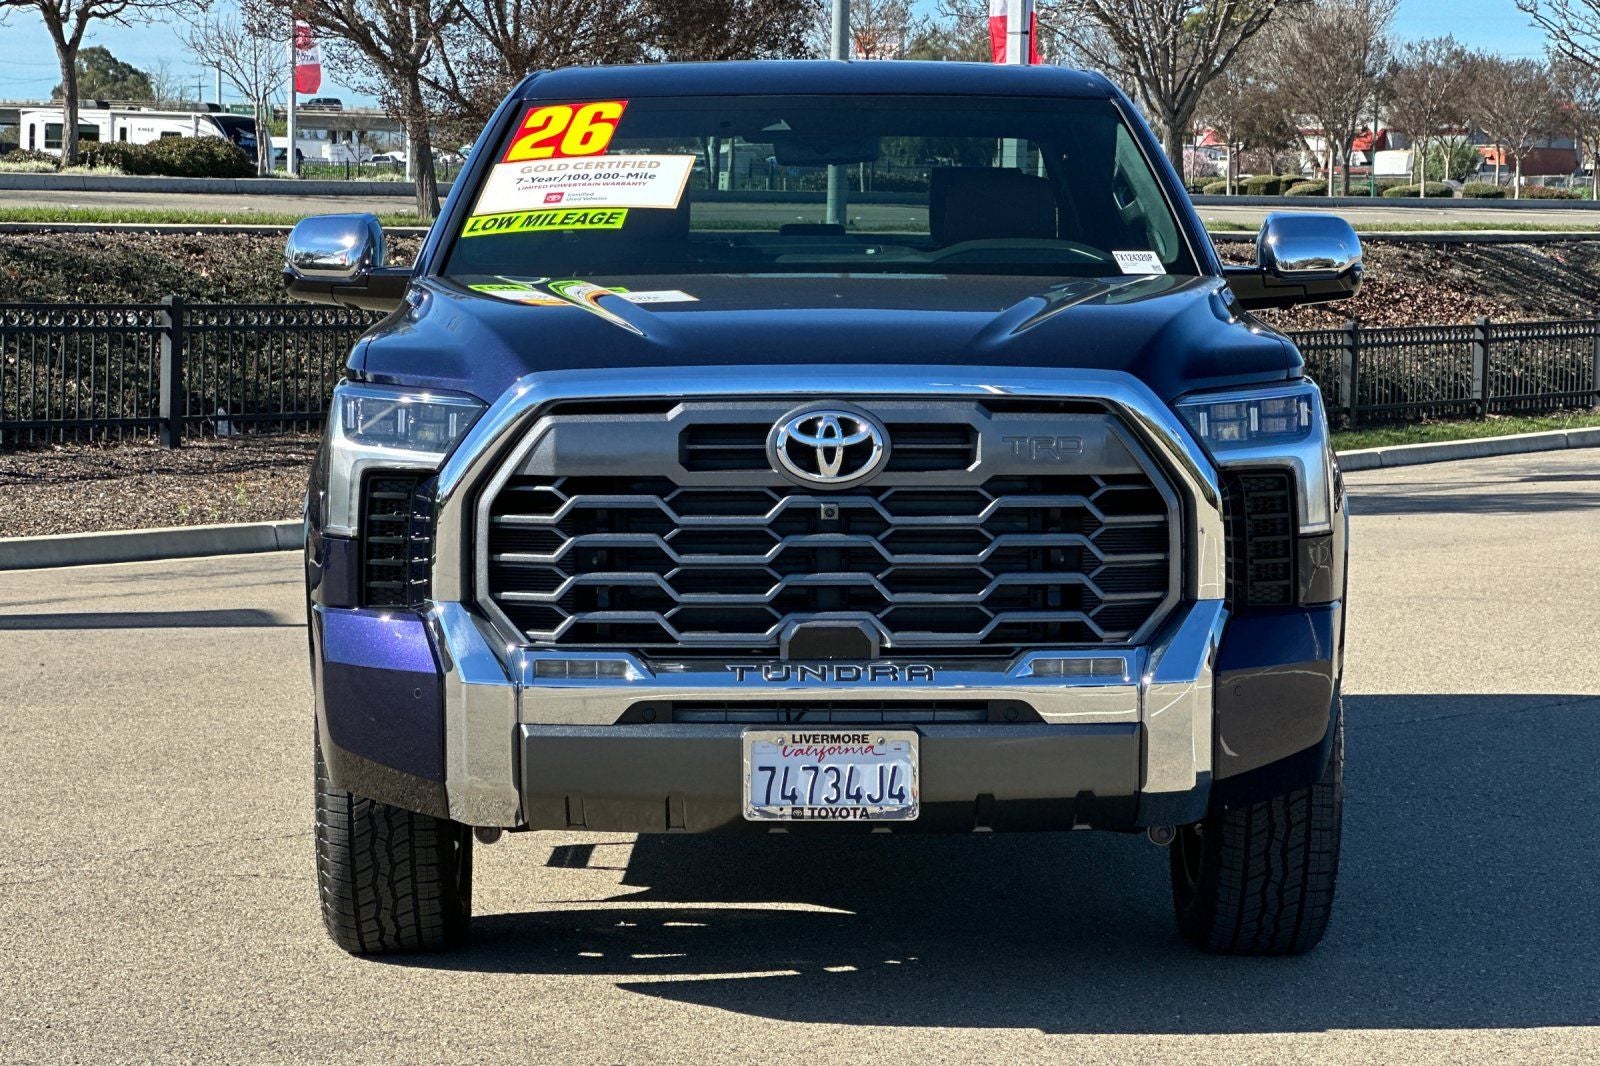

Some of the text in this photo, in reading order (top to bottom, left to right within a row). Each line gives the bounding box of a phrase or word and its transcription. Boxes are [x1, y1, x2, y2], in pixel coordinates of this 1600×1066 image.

[506, 101, 624, 161] 26
[520, 160, 661, 174] GOLD CERTIFIED
[515, 172, 657, 185] 7-Year/100,000-Mile
[467, 210, 622, 233] LOW MILEAGE
[1001, 436, 1083, 460] TRD
[725, 664, 936, 682] TUNDRA
[791, 734, 870, 744] LIVERMORE
[782, 744, 886, 762] California
[758, 766, 906, 806] 74734J4
[808, 807, 870, 819] TOYOTA
